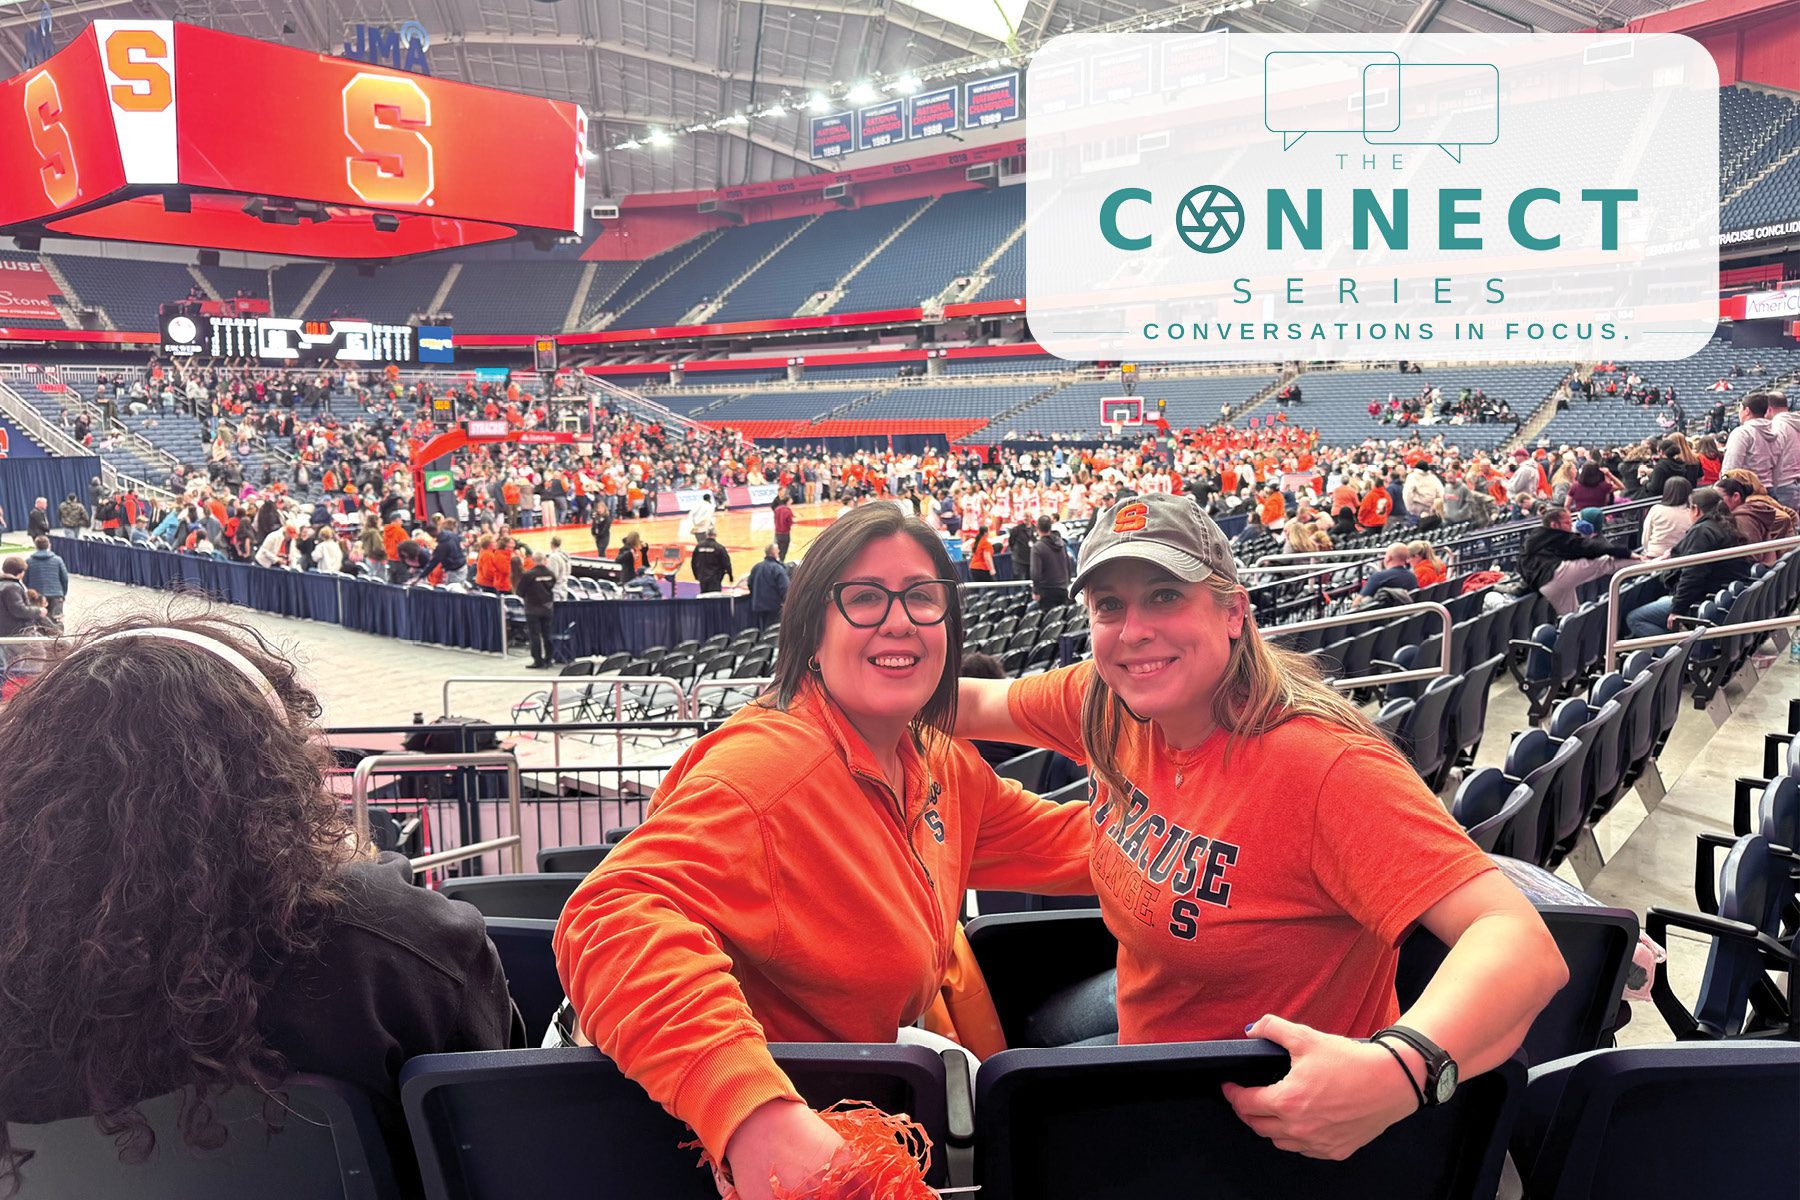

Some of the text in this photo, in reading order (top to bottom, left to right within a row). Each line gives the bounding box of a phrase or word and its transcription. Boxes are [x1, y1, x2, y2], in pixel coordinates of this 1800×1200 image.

[344, 24, 430, 76] JMA
[105, 30, 173, 112] S
[916, 102, 950, 117] NATIONAL
[969, 98, 1014, 115] CHAMPIONS
[972, 89, 1009, 104] NATIONAL
[913, 110, 954, 126] CHAMPIONS
[25, 69, 78, 209] S
[342, 72, 434, 205] S
[1755, 221, 1800, 239] CONCLUD
[0, 259, 43, 272] USE
[1113, 502, 1149, 533] S
[923, 809, 945, 844] S
[1169, 899, 1200, 941] S
